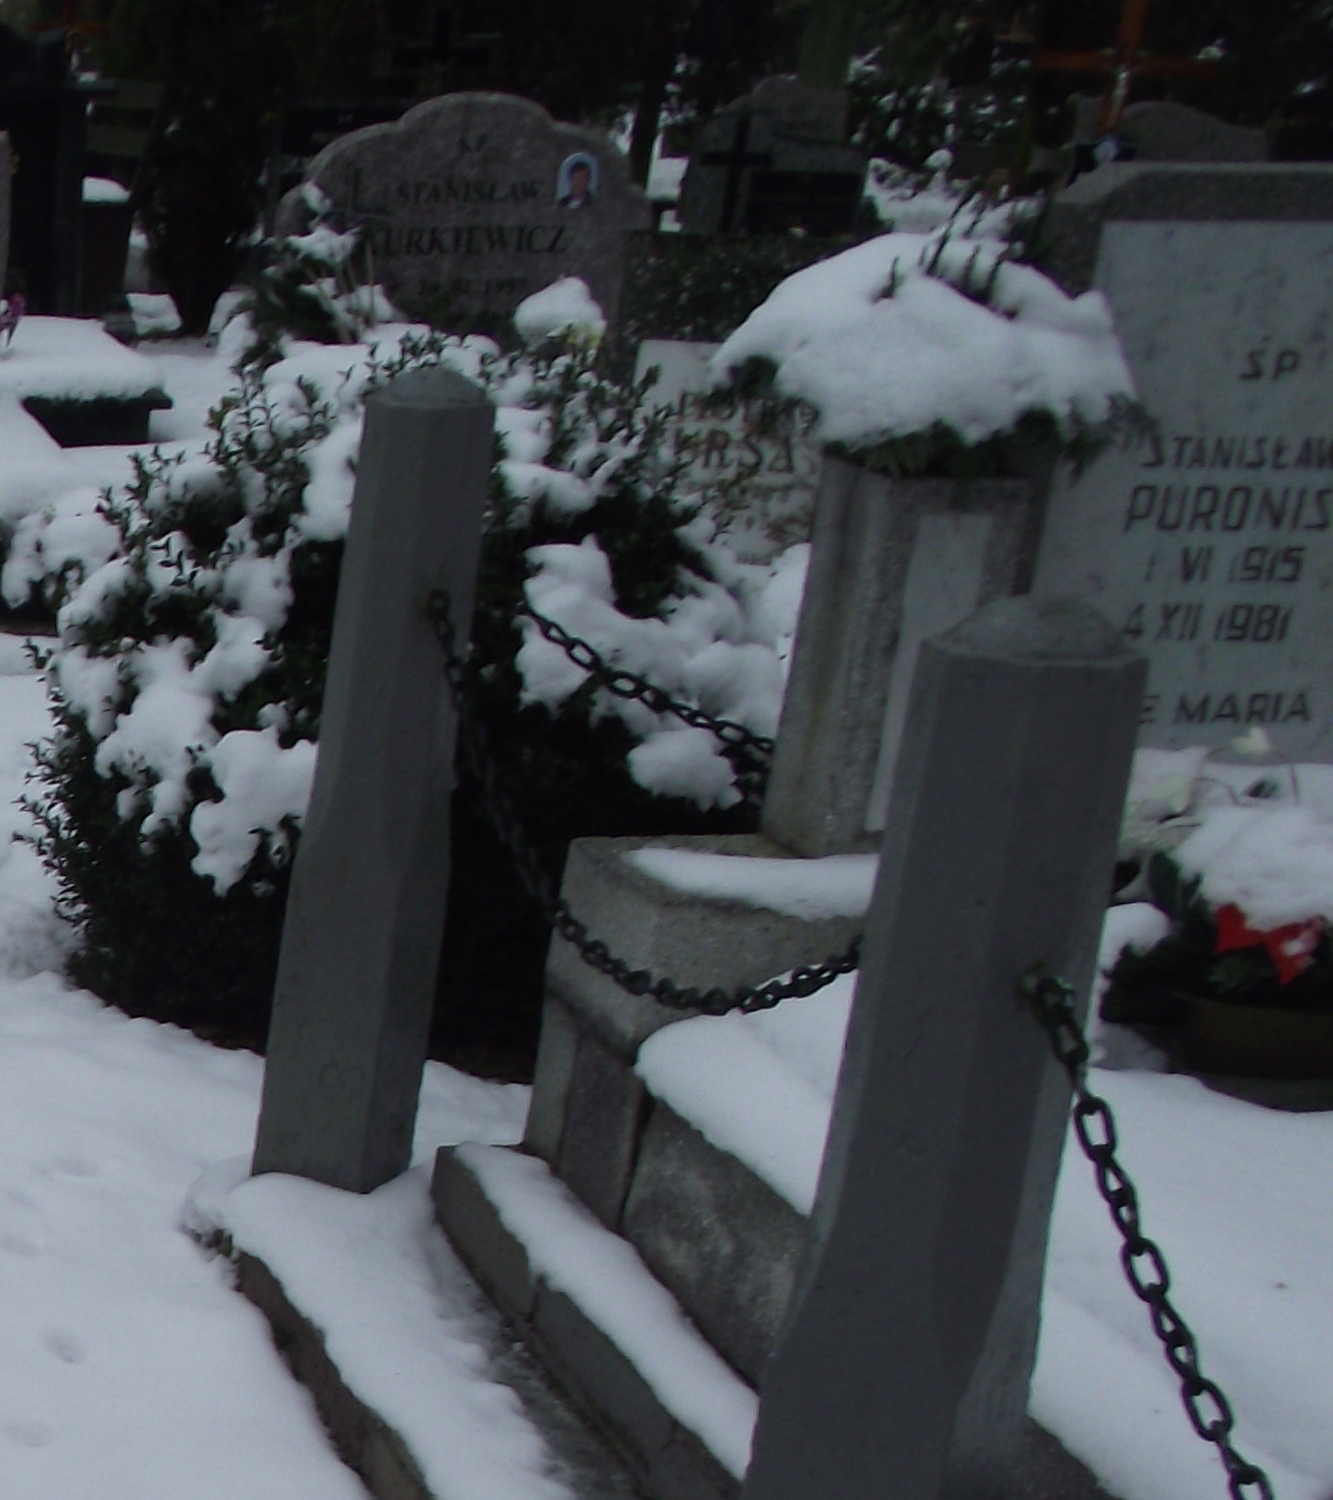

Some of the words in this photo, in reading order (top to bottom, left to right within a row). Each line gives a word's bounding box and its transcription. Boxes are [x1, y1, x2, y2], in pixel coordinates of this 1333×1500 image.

[1226, 545, 1308, 585] 1915
[1154, 601, 1205, 643] XII
[1212, 602, 1294, 643] 1981
[1171, 690, 1312, 726] MARIA
